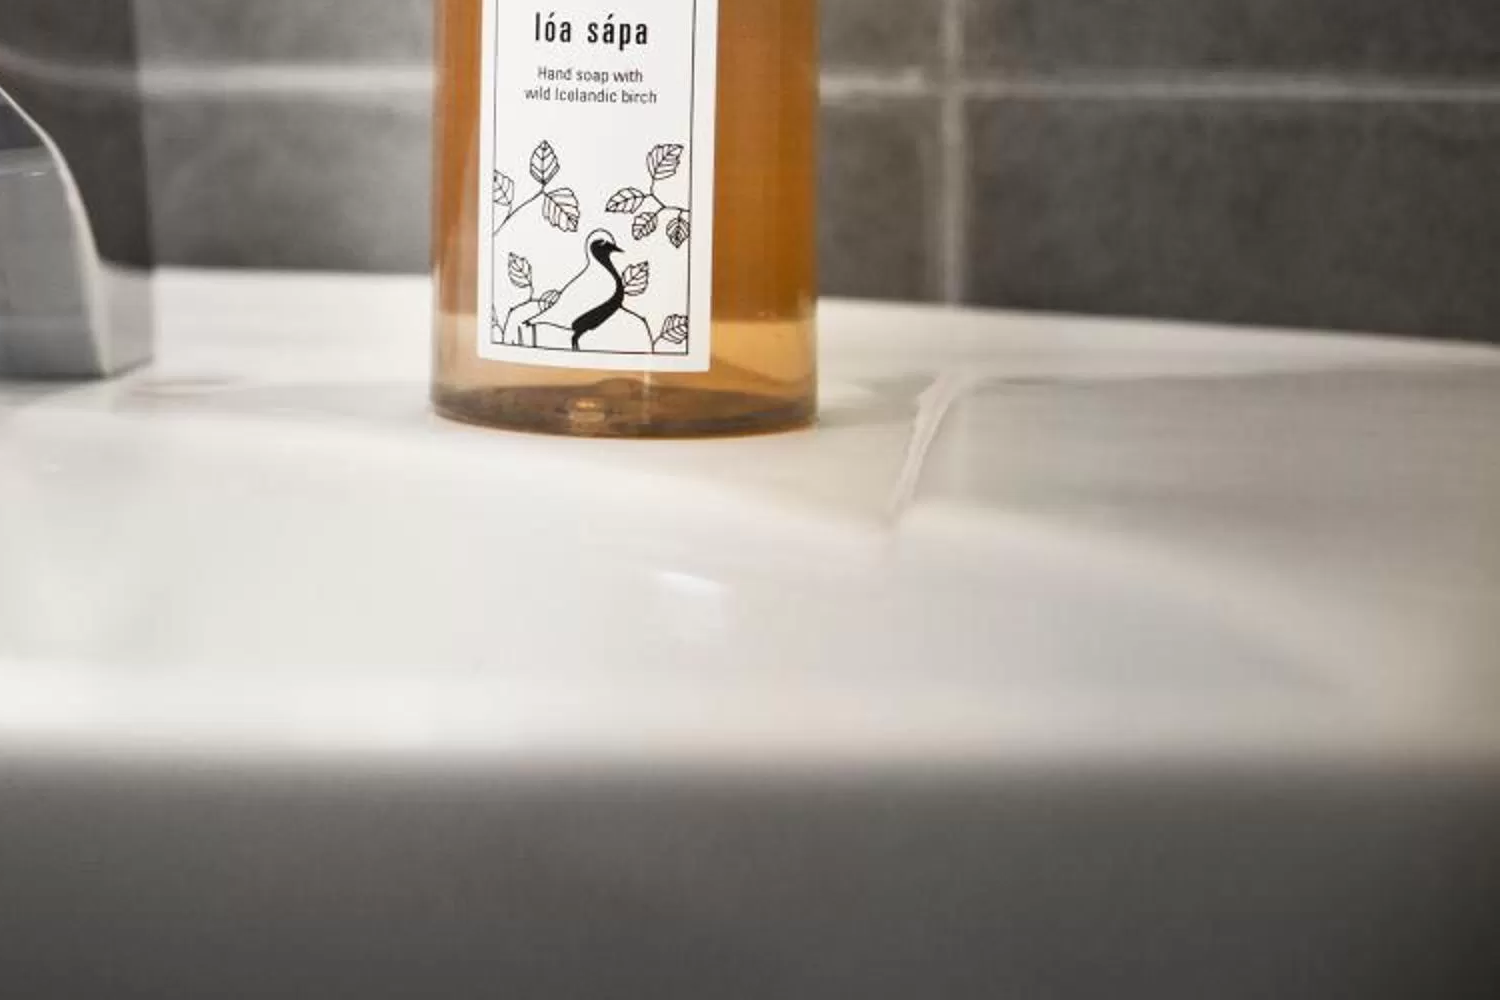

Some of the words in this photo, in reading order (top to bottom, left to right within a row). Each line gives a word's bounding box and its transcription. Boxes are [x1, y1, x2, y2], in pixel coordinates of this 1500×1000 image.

[535, 12, 572, 43] lóa
[587, 13, 648, 51] sápa
[537, 66, 572, 81] Hand
[576, 68, 609, 84] soap
[613, 67, 643, 82] with
[524, 87, 551, 101] wild
[555, 87, 617, 103] Icelandic
[621, 88, 657, 104] birch
